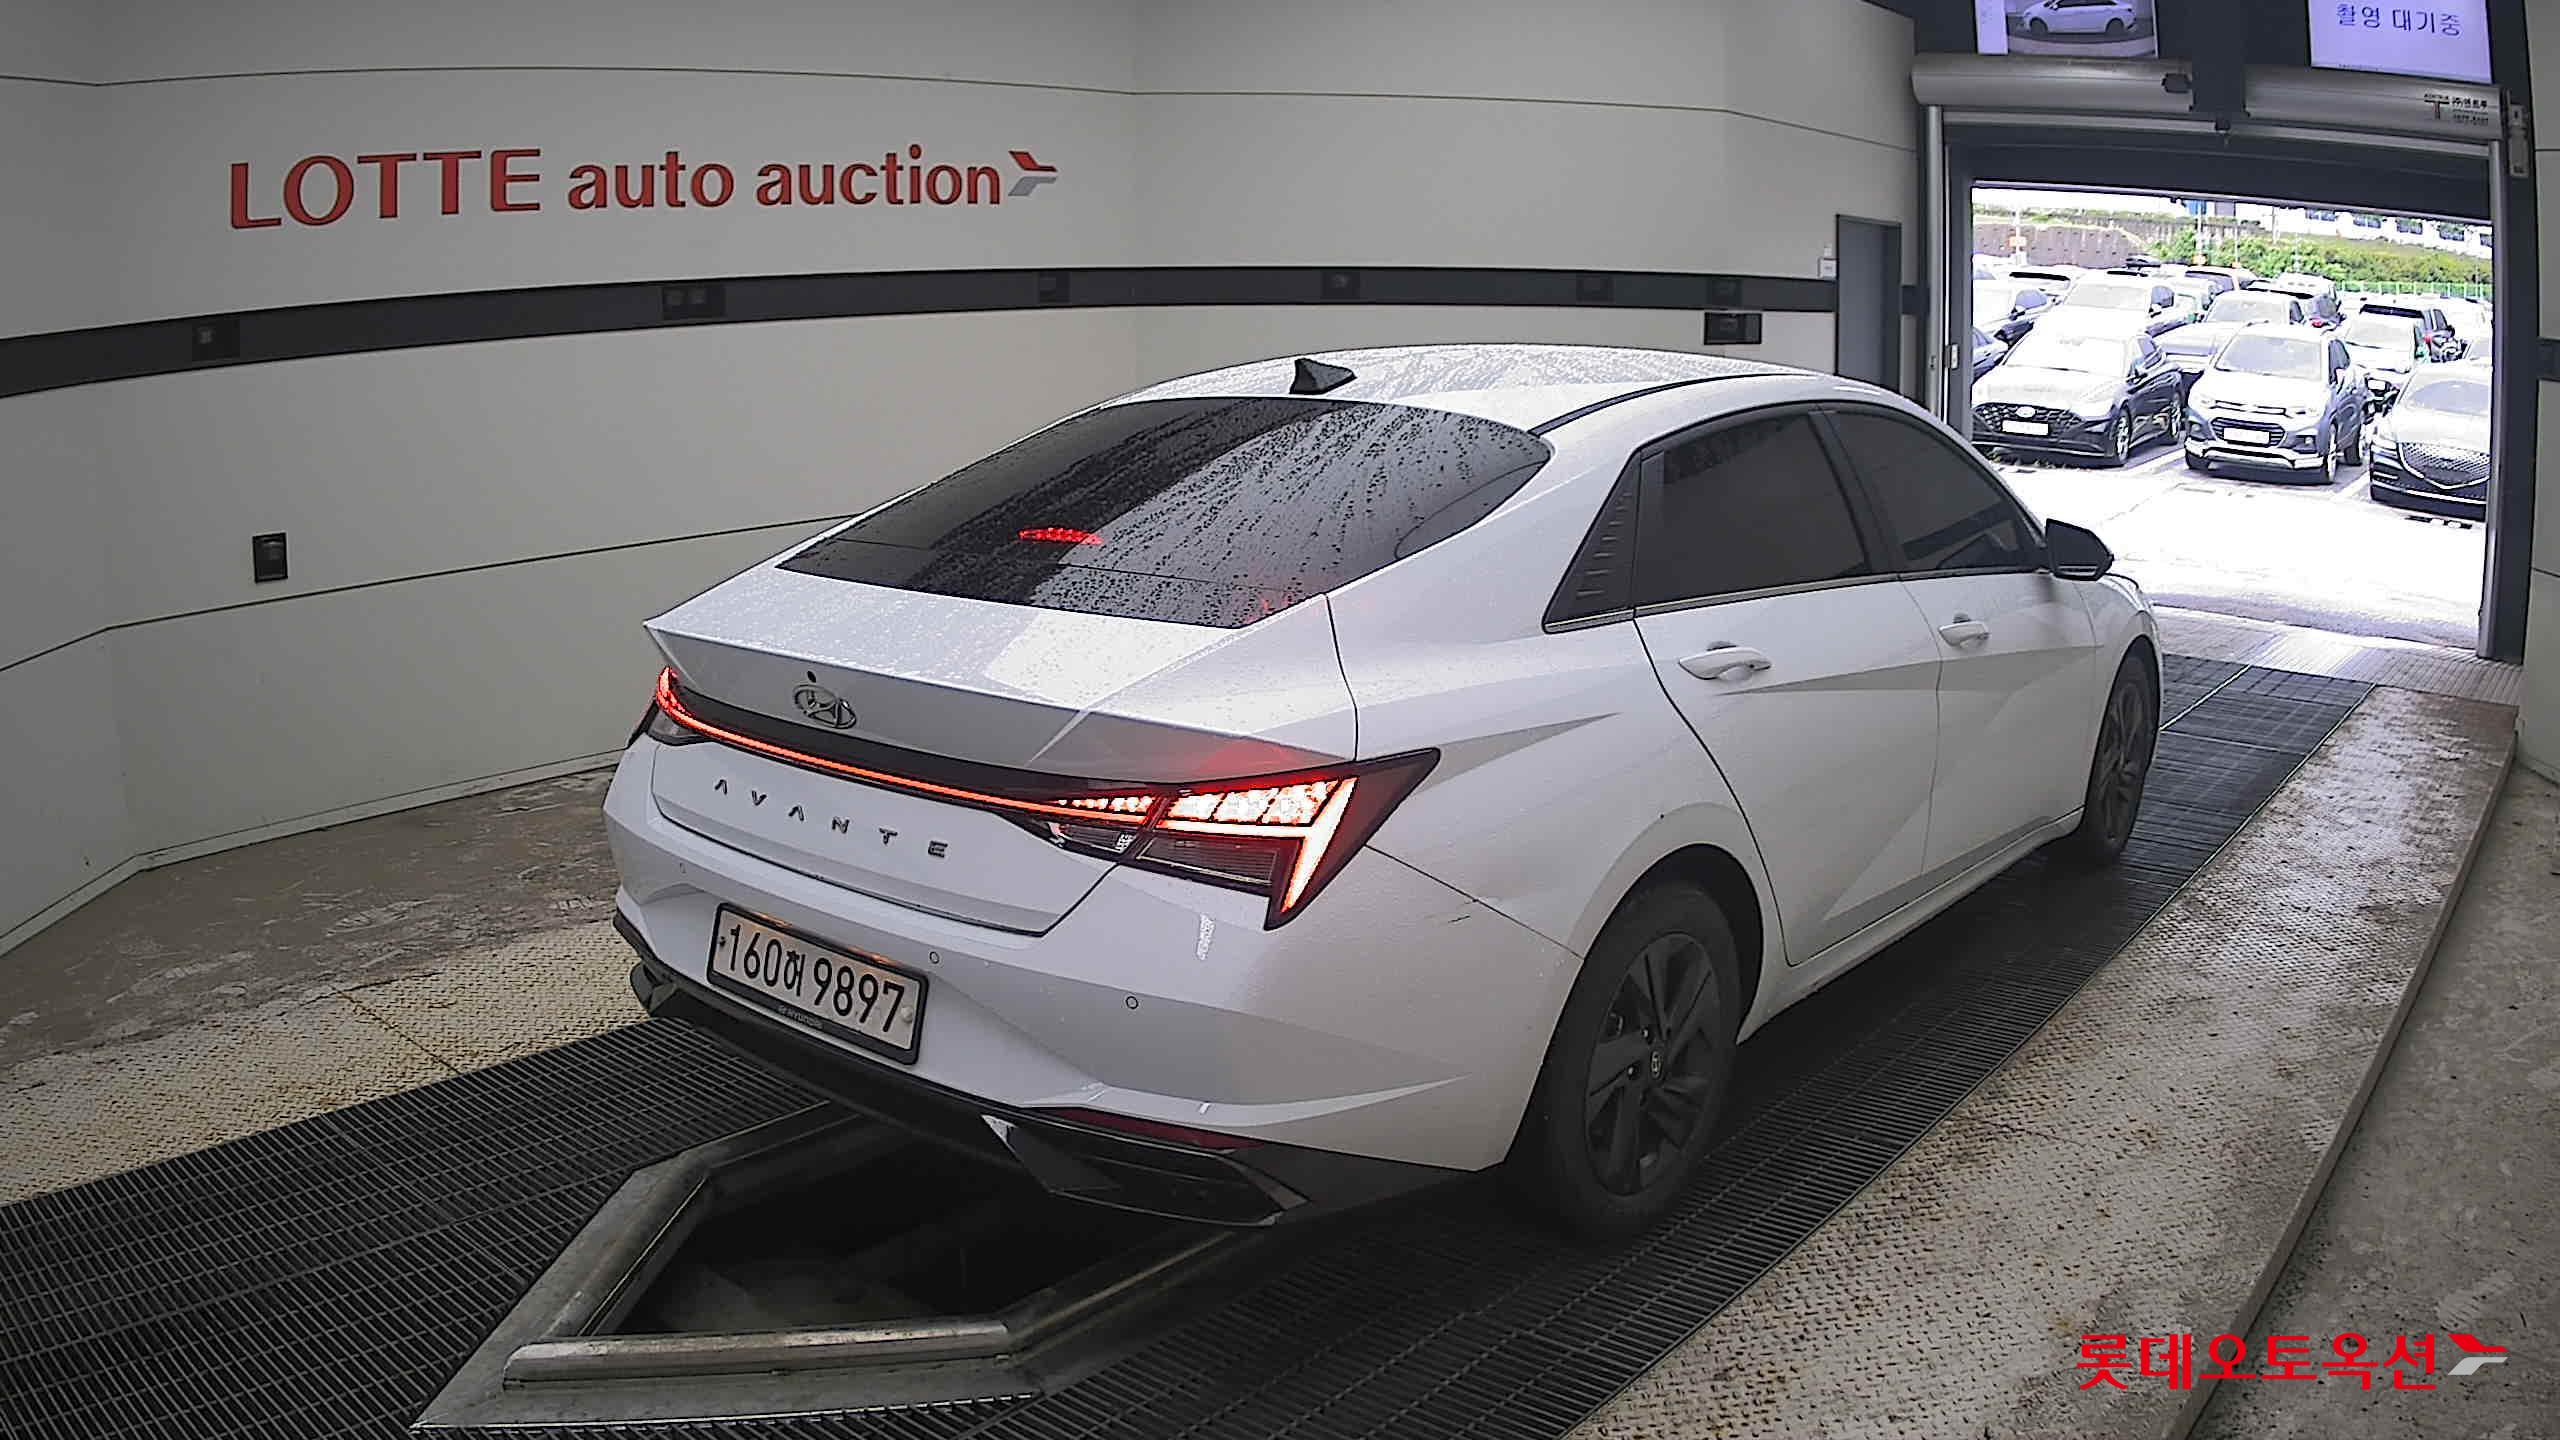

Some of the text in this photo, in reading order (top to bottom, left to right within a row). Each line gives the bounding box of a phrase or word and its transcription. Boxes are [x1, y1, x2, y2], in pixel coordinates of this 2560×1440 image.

[2337, 4, 2460, 37] 촬영 대기중
[229, 144, 1000, 229] LOTTE auto auction
[714, 778, 948, 858] AVANTE
